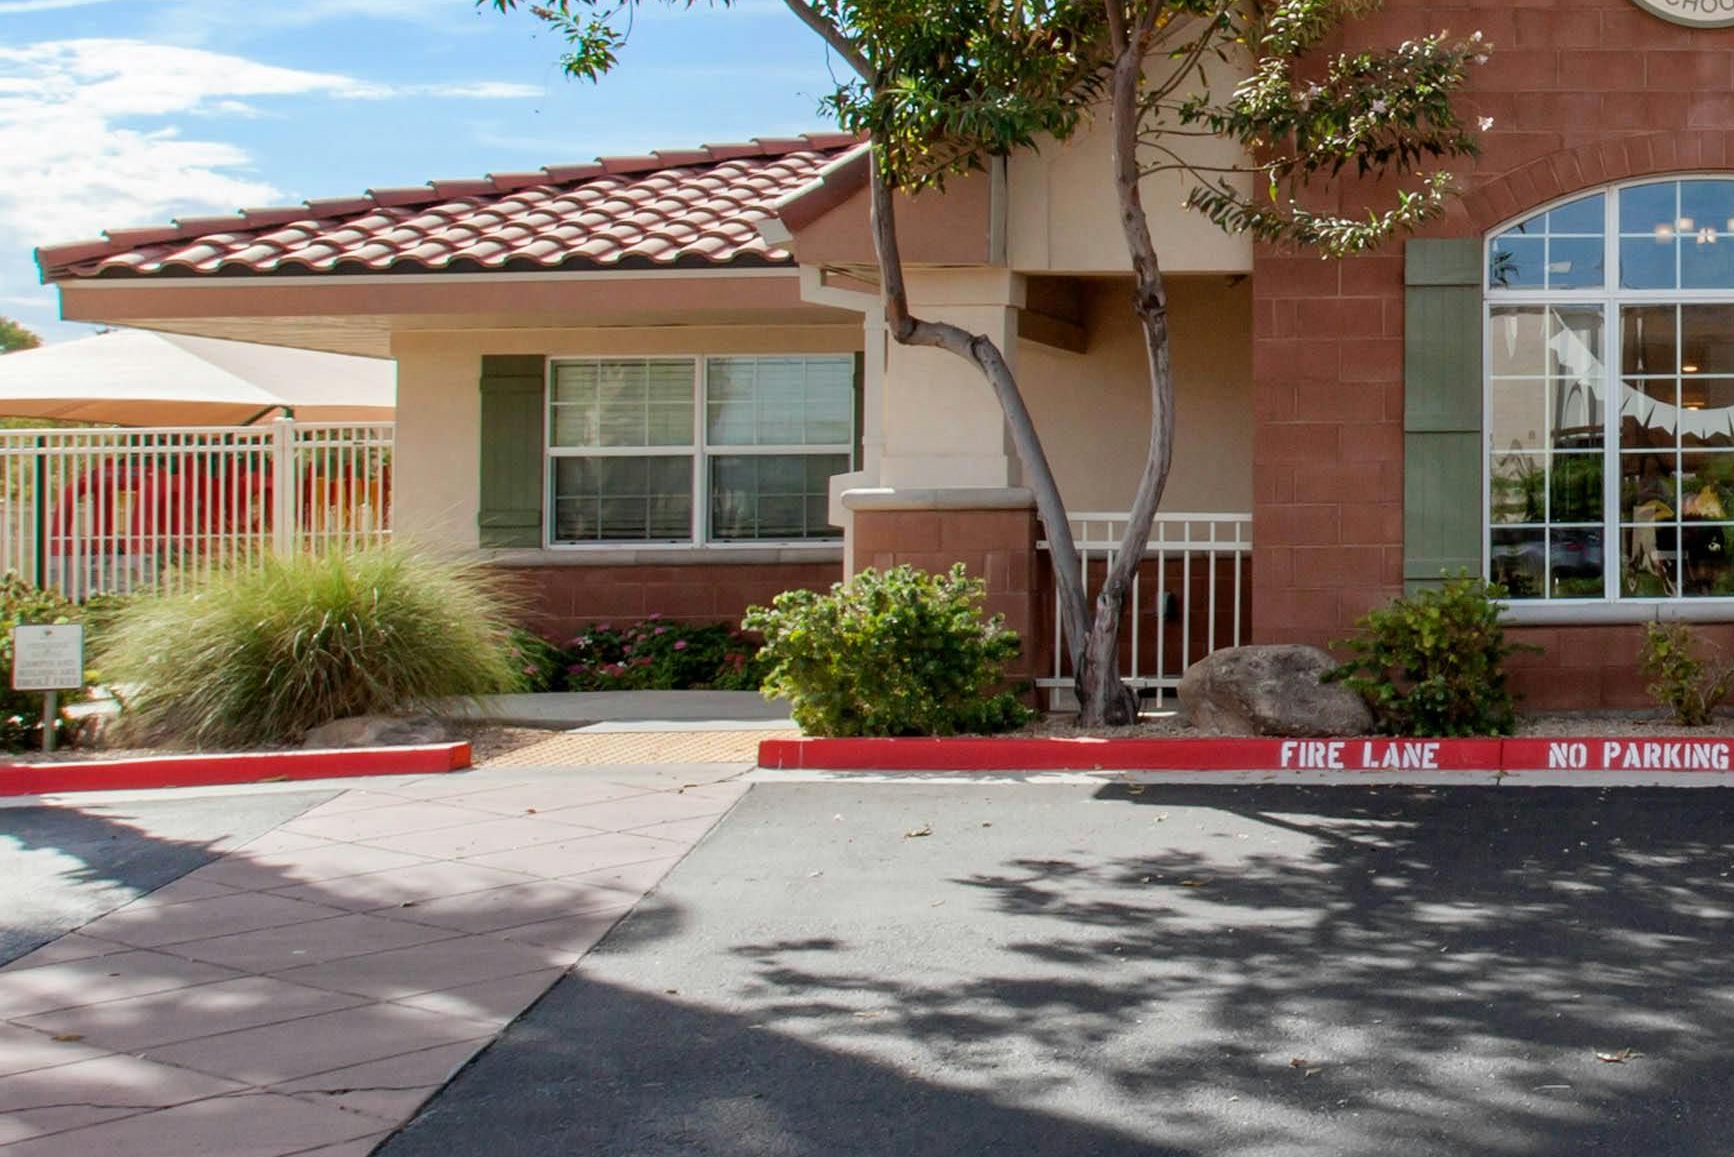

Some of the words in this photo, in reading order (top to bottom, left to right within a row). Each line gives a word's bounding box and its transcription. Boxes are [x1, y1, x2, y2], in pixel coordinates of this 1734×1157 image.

[1280, 741, 1346, 769] FIRE
[1362, 741, 1441, 769] LANE
[1548, 741, 1588, 769] NO
[1603, 741, 1730, 770] PARKING
